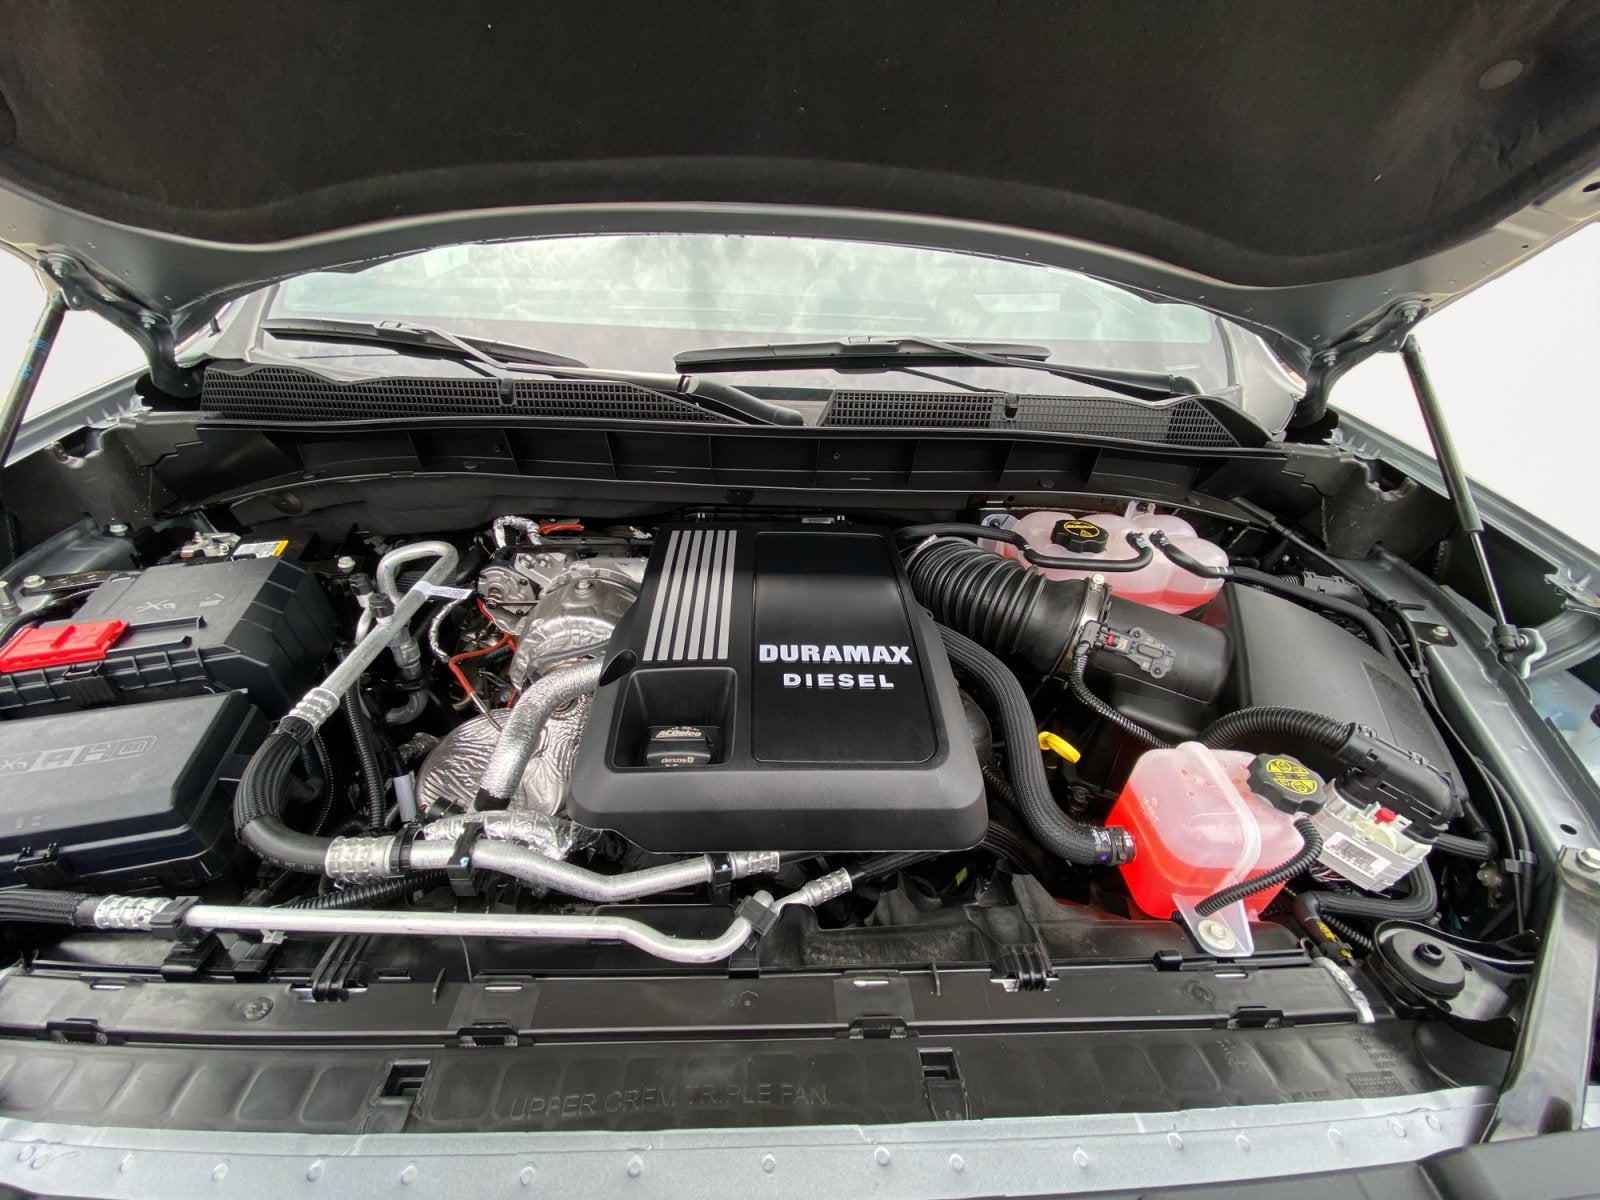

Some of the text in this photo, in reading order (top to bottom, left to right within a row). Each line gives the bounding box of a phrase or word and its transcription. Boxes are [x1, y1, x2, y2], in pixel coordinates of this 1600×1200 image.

[759, 644, 913, 665] DURAMAX
[783, 673, 895, 690] DIESEL
[655, 730, 702, 738] ACDelco
[510, 1092, 598, 1121] UPPER
[780, 1082, 827, 1105] FAN
